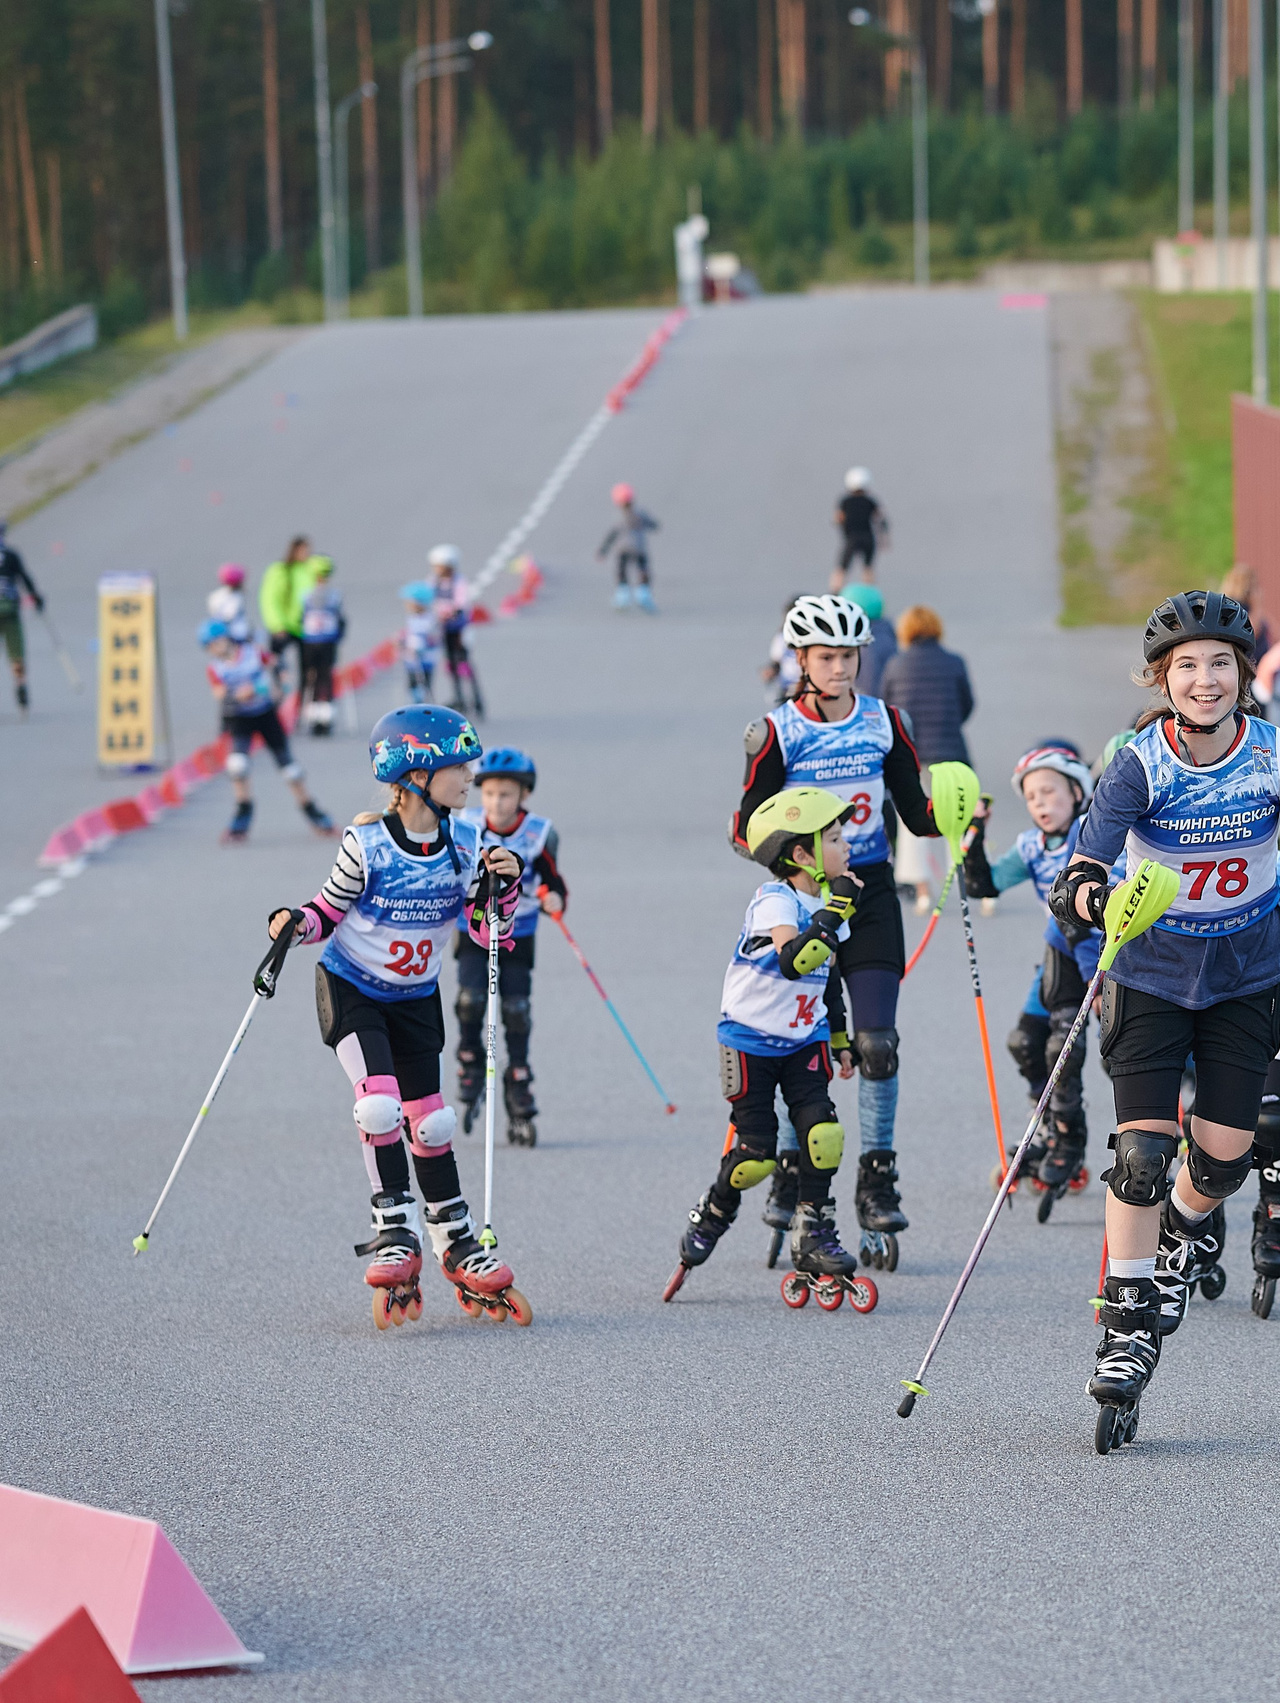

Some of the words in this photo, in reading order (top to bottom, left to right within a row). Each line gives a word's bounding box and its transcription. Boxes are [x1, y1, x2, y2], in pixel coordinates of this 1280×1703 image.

[815, 765, 871, 781] ОБЛАСТЬ
[957, 786, 965, 821] LEKI
[1179, 827, 1253, 845] ОБЛАСТЬ
[1181, 857, 1249, 901] 78
[1124, 873, 1150, 919] LEKI
[391, 910, 442, 922] ОБЛАСТЬ
